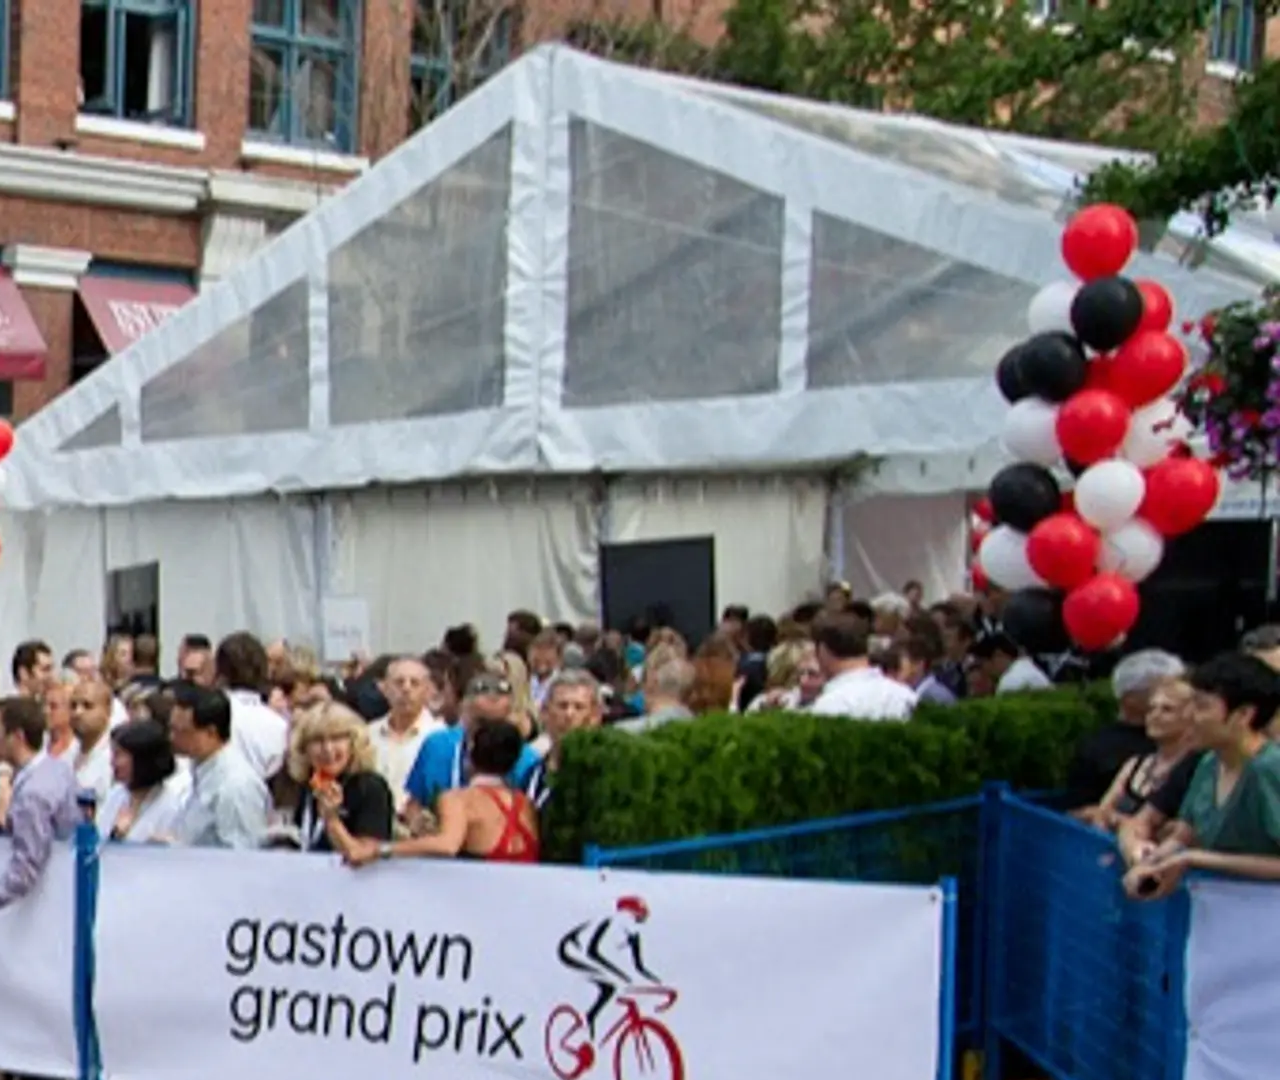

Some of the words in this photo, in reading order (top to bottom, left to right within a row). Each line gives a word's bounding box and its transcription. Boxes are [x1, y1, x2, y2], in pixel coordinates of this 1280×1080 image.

[226, 912, 473, 982] gastown
[230, 982, 397, 1043] grand
[412, 996, 526, 1064] prix
